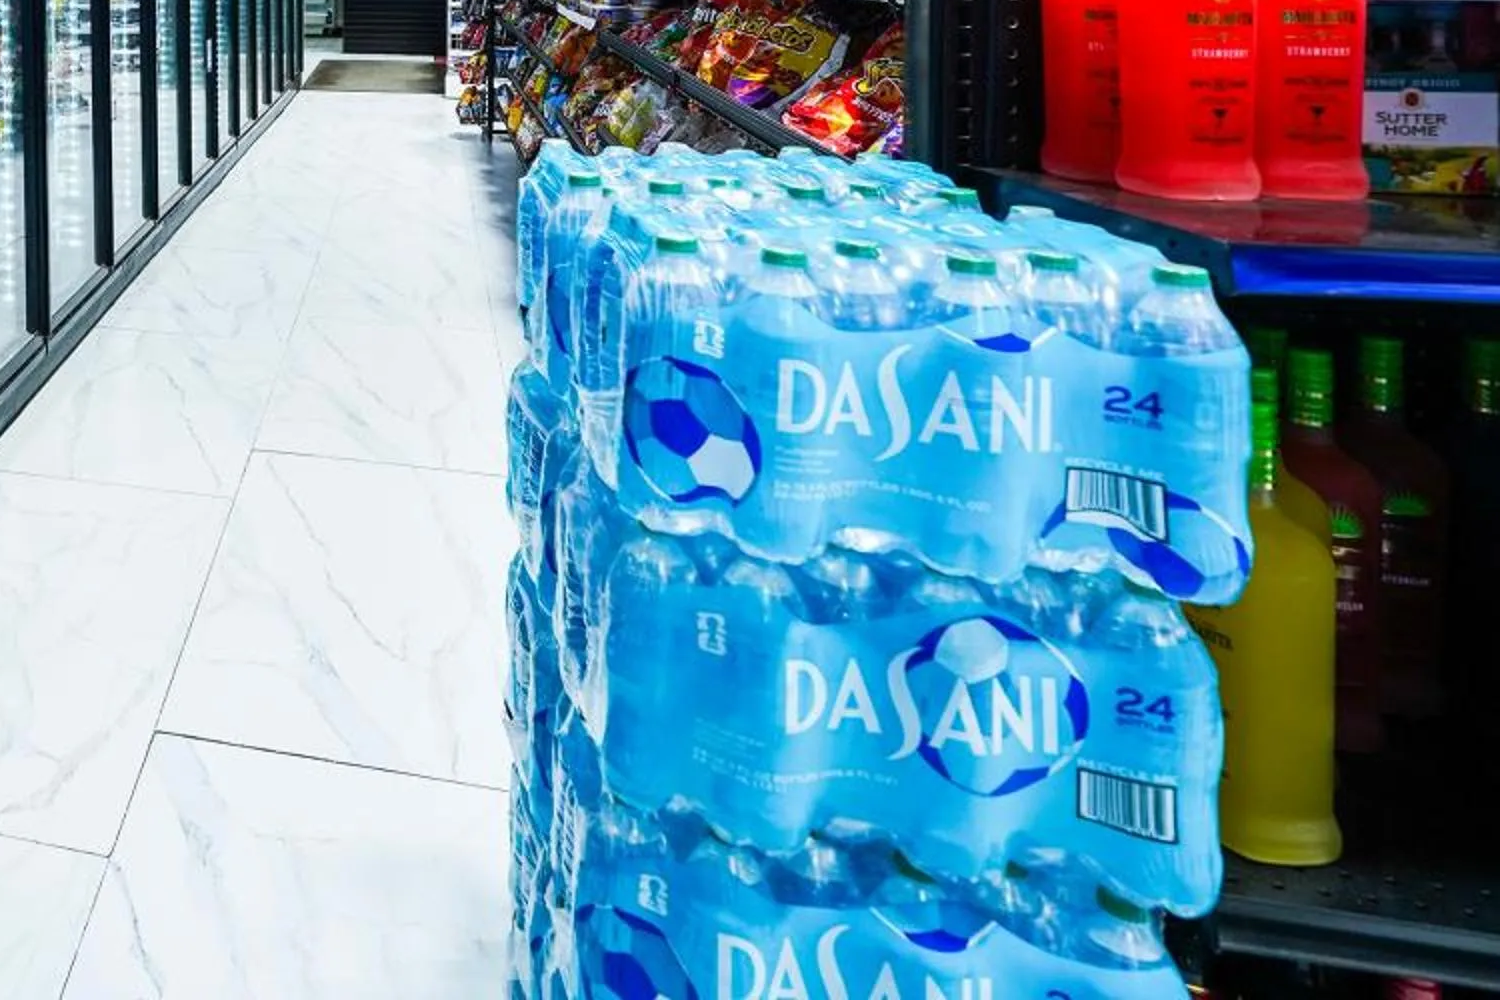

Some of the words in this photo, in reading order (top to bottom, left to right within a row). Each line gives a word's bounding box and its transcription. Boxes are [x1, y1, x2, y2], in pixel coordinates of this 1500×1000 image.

[1286, 45, 1351, 58] STRAWBERRY
[1375, 110, 1449, 126] SUTTER
[1384, 124, 1439, 138] HOME
[775, 344, 1055, 462] DASANI
[1103, 386, 1165, 417] 24
[785, 647, 1060, 761] DASANI
[1115, 687, 1176, 722] 24
